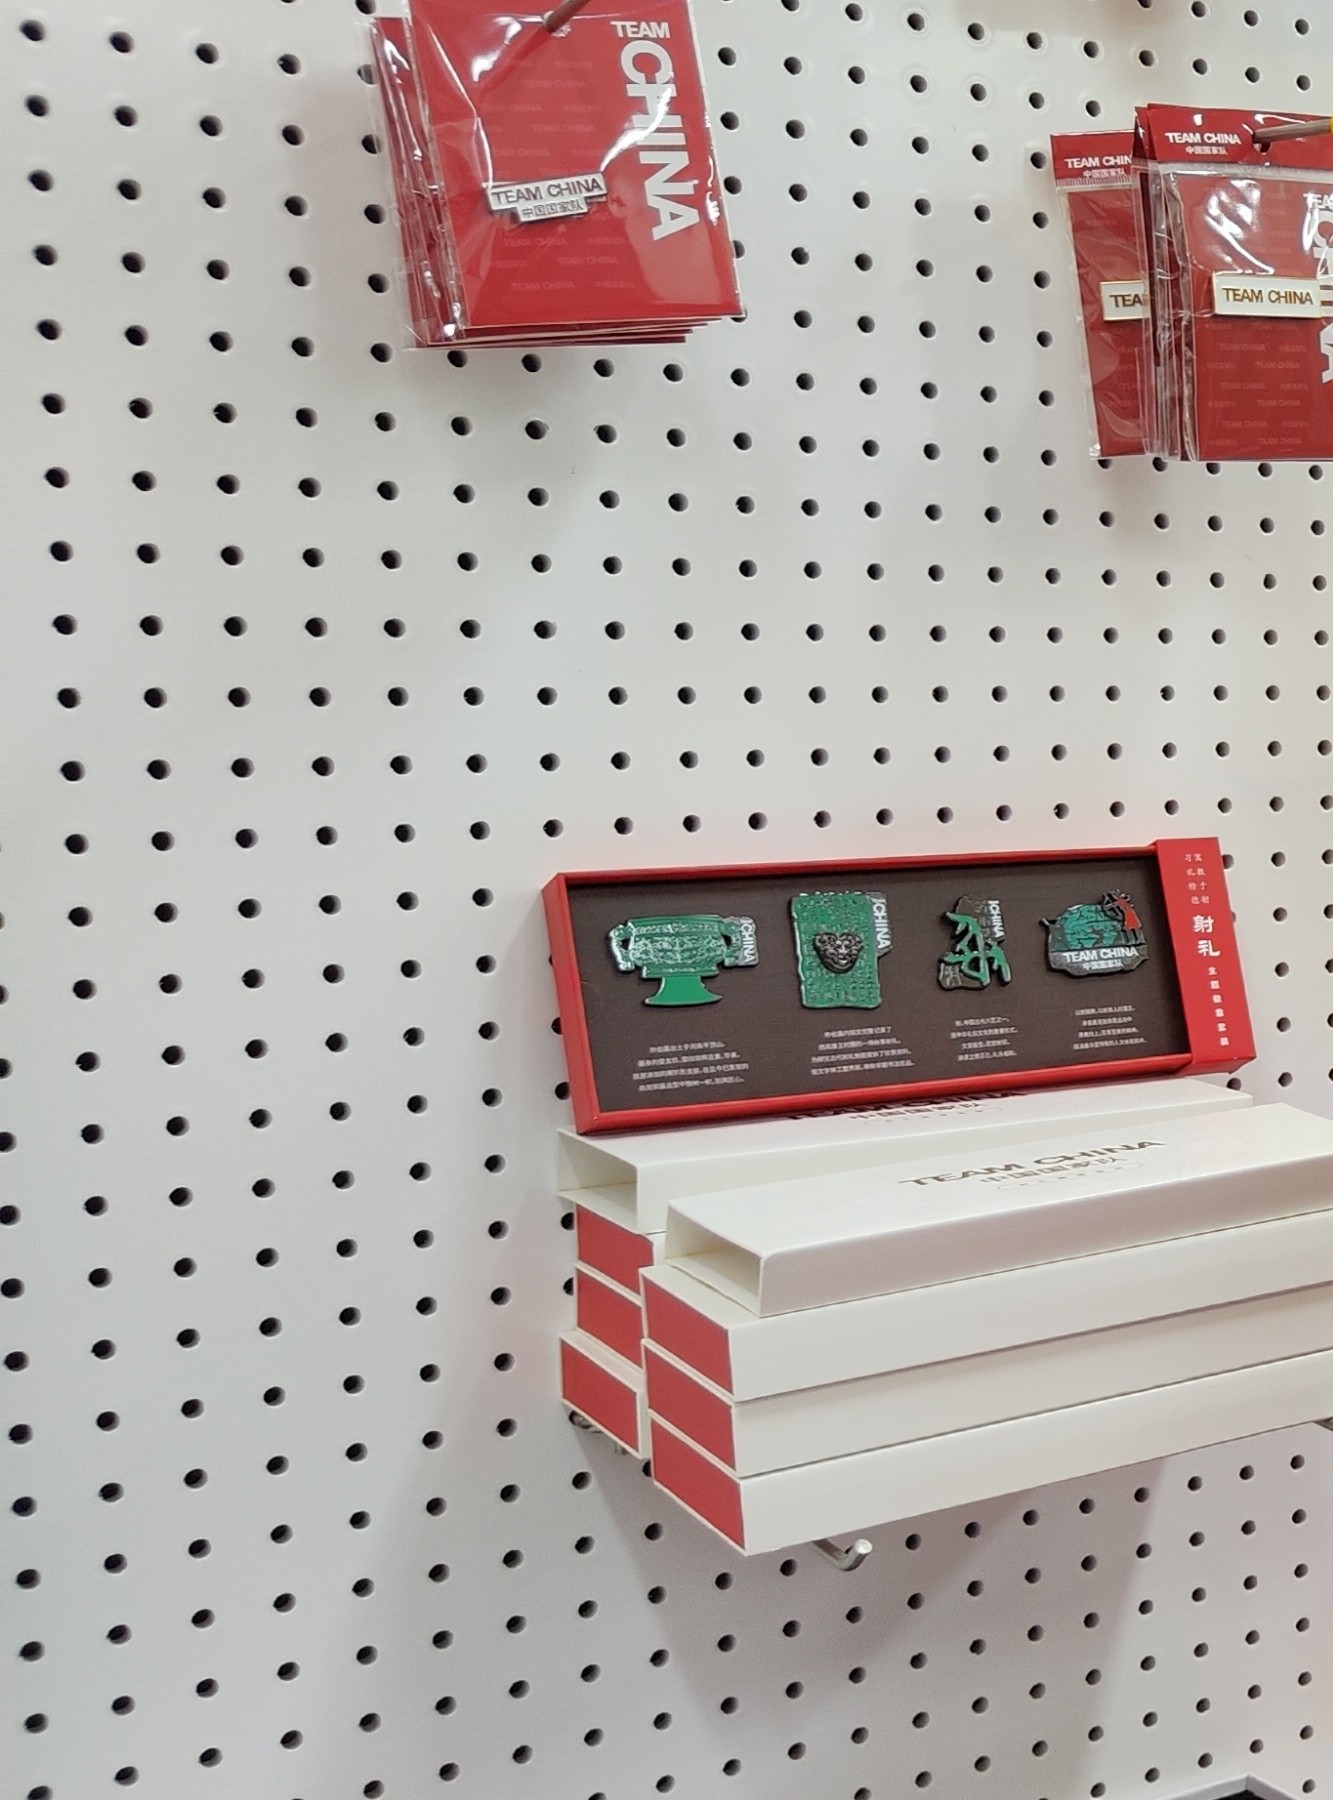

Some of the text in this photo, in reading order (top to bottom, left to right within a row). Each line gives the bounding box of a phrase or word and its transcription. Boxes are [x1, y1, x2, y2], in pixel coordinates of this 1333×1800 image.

[610, 20, 670, 39] TEAM
[620, 40, 700, 241] CHINA
[1165, 132, 1242, 145] TEAM CHINA
[1065, 155, 1133, 169] TEAM CHIN
[491, 177, 604, 204] TEAM CHINA
[521, 199, 583, 219] 中国国家队
[1222, 287, 1313, 305] TEAM CHINA
[871, 905, 891, 950] CHINA
[987, 906, 1005, 938] CHINA
[740, 924, 757, 964] CHINA
[1063, 946, 1139, 964] TEAM CHINA
[898, 1163, 1028, 1186] TEAM
[1033, 1140, 1166, 1165] CHINA
[980, 1156, 1129, 1184] 中国国家队
